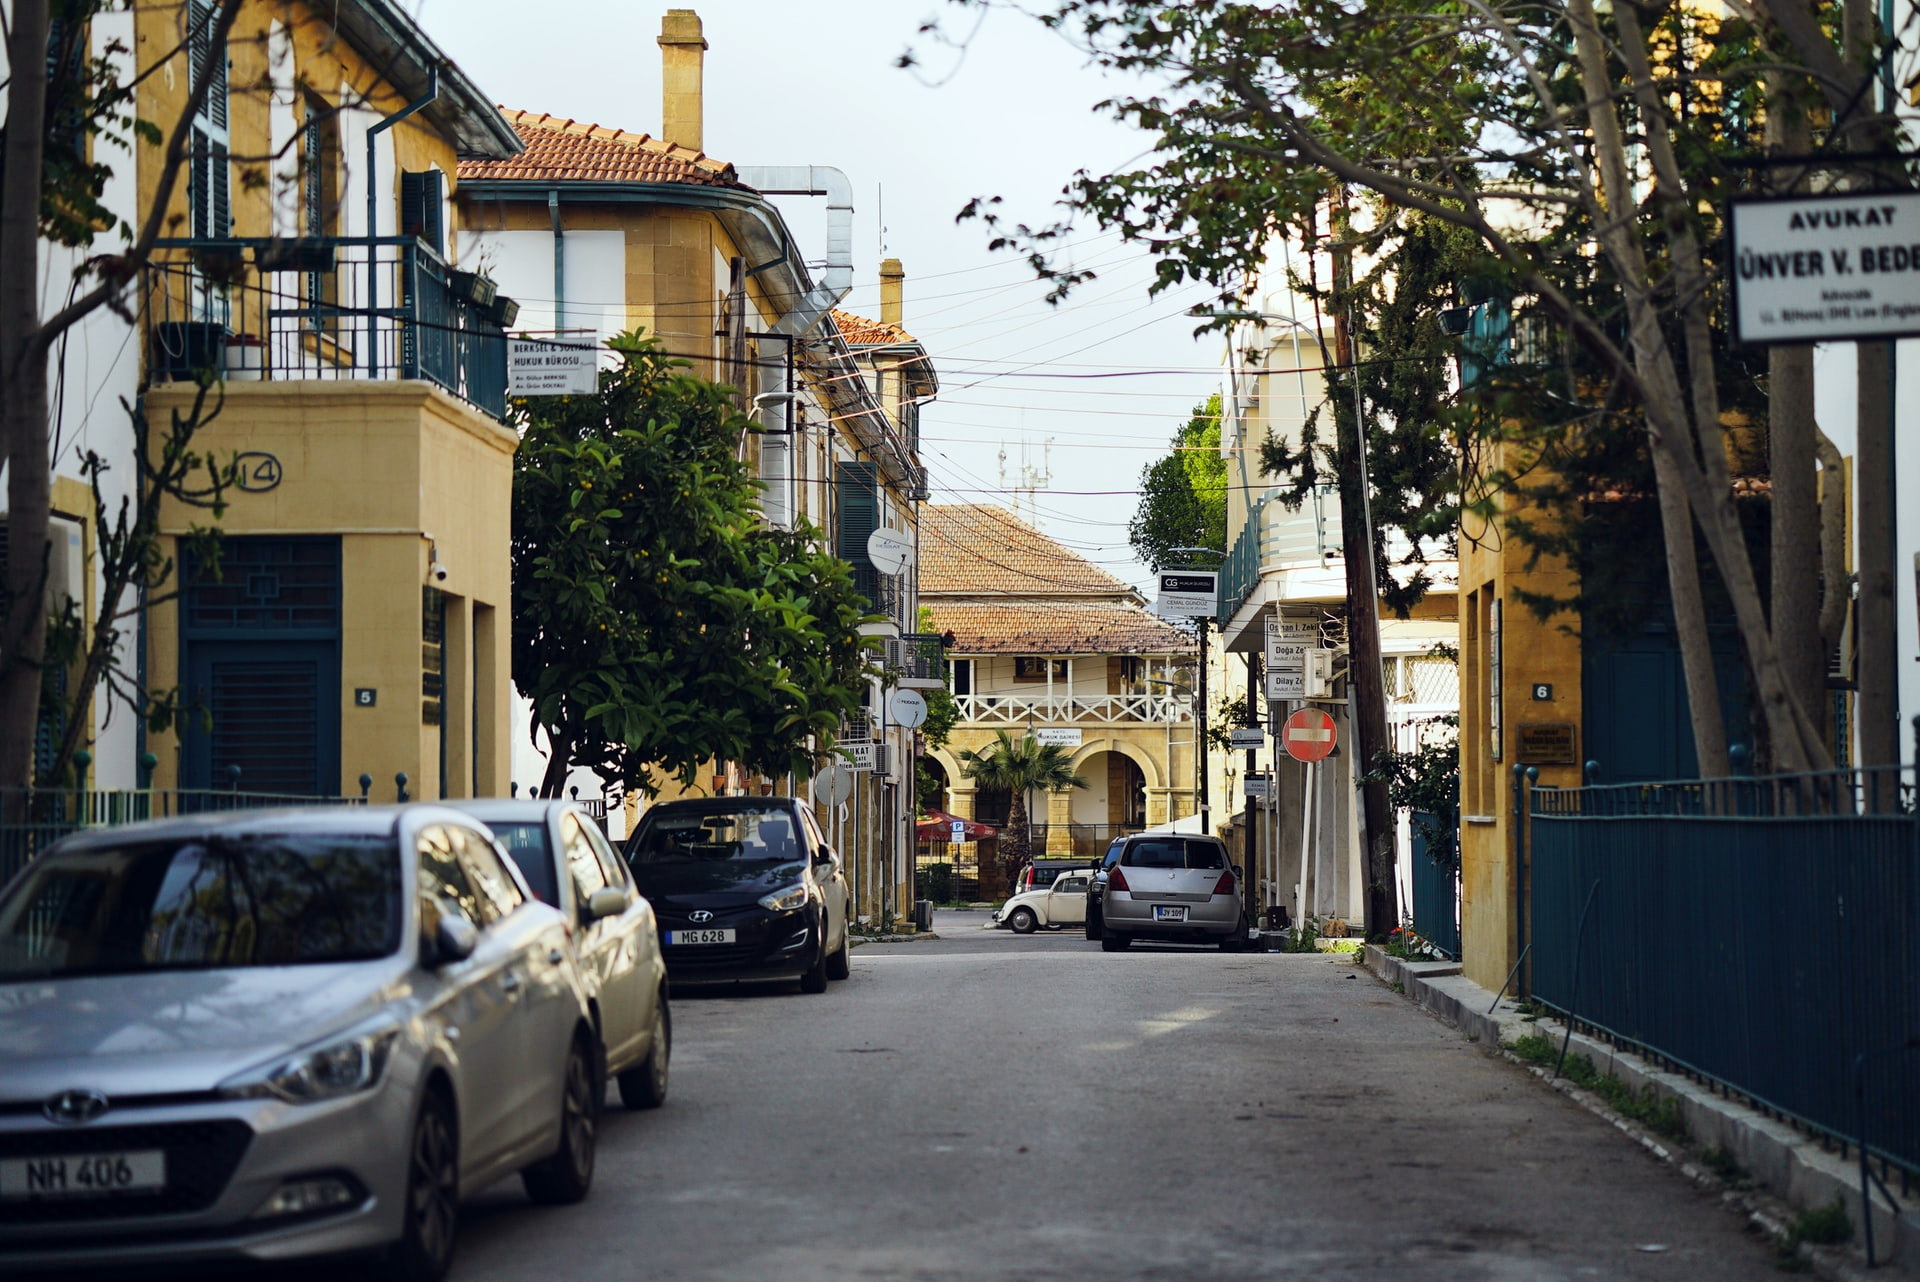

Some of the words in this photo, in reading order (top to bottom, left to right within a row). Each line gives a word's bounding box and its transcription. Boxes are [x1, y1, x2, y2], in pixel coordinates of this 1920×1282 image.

[1789, 206, 1896, 231] AVUKAT
[1739, 247, 1824, 280] ÜNVER
[1831, 249, 1853, 275] V.
[514, 343, 548, 353] BERKSEL
[514, 357, 543, 366] HUKUK
[546, 354, 579, 366] BÜROSU
[242, 460, 276, 486] 14
[1165, 578, 1178, 587] CG
[1302, 623, 1317, 631] Zeki
[1276, 677, 1293, 686] Dilay
[360, 691, 371, 704] 5
[1537, 686, 1548, 698] 6
[1171, 909, 1182, 917] 109
[682, 931, 698, 943] MG
[701, 930, 725, 943] 628
[26, 1158, 68, 1189] NH
[76, 1156, 133, 1186] 406
